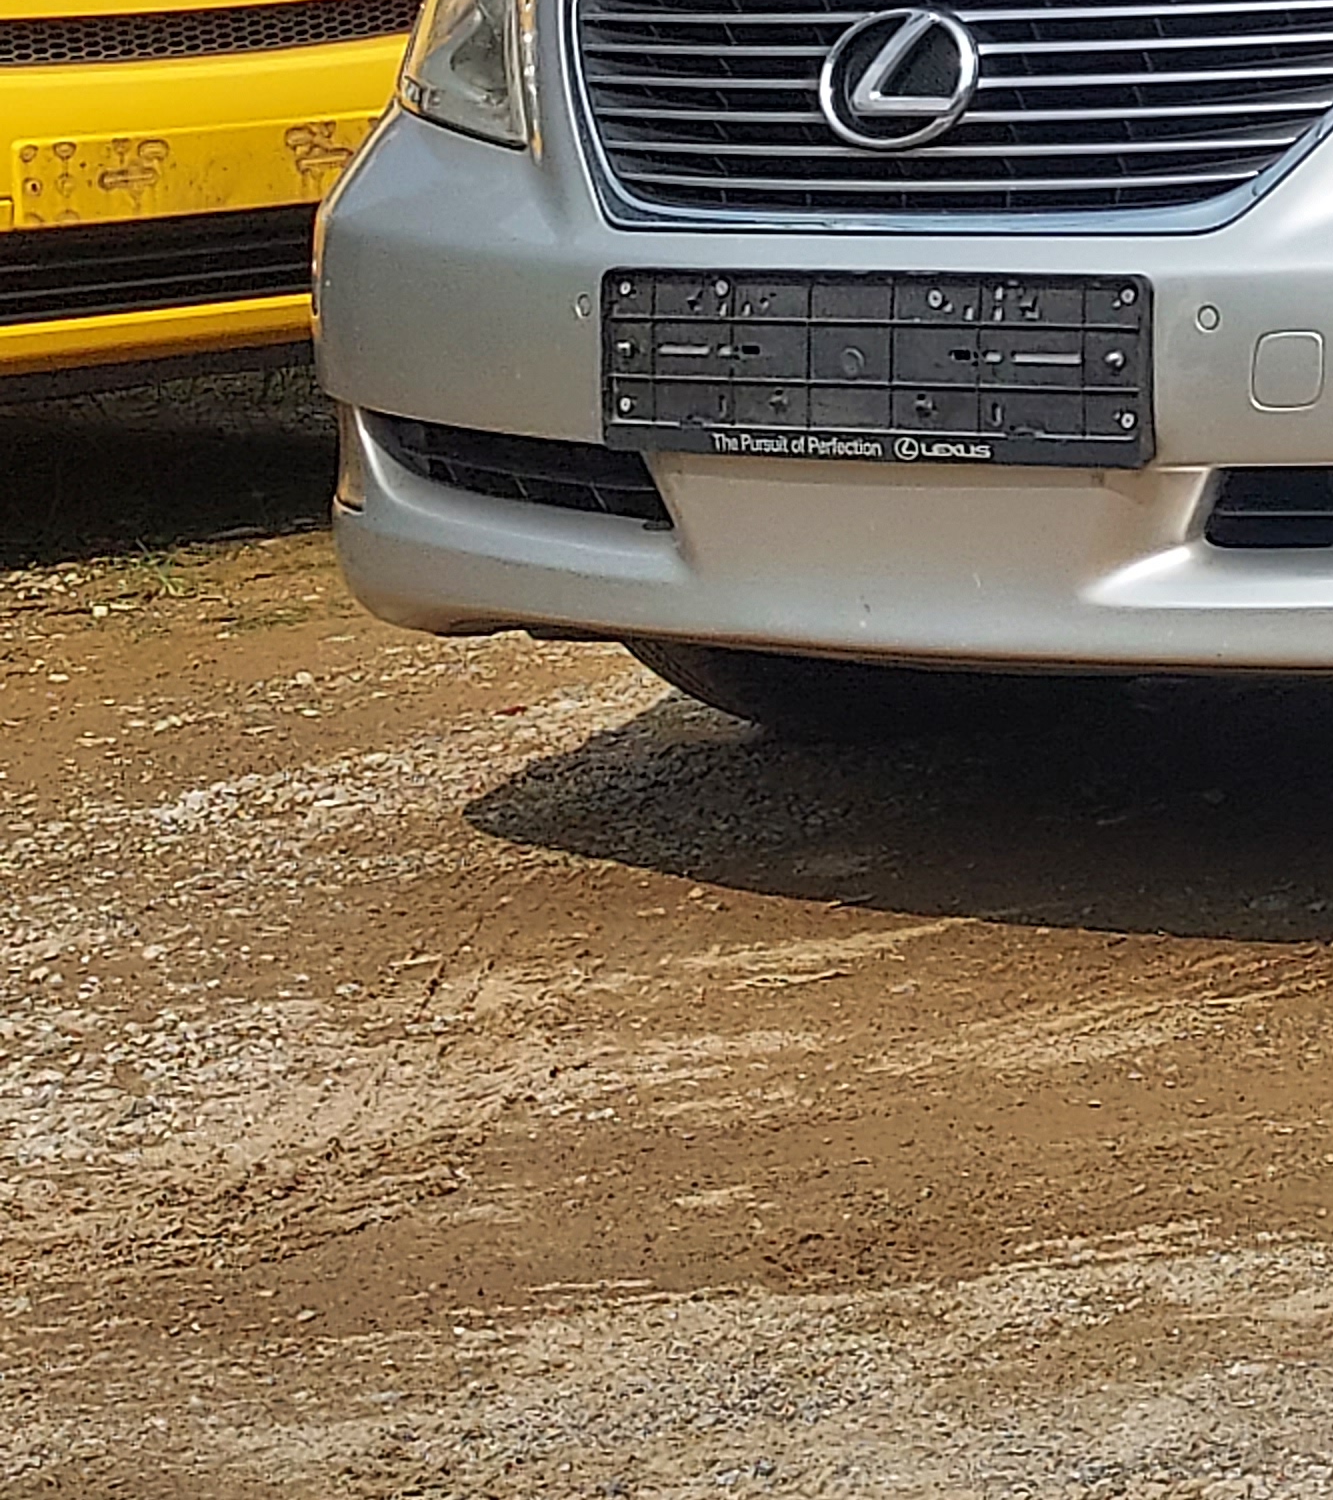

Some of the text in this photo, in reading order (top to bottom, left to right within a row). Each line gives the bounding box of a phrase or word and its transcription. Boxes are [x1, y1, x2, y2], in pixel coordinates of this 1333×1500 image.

[711, 433, 992, 458] The Pursuit of Perfection LEXUS
